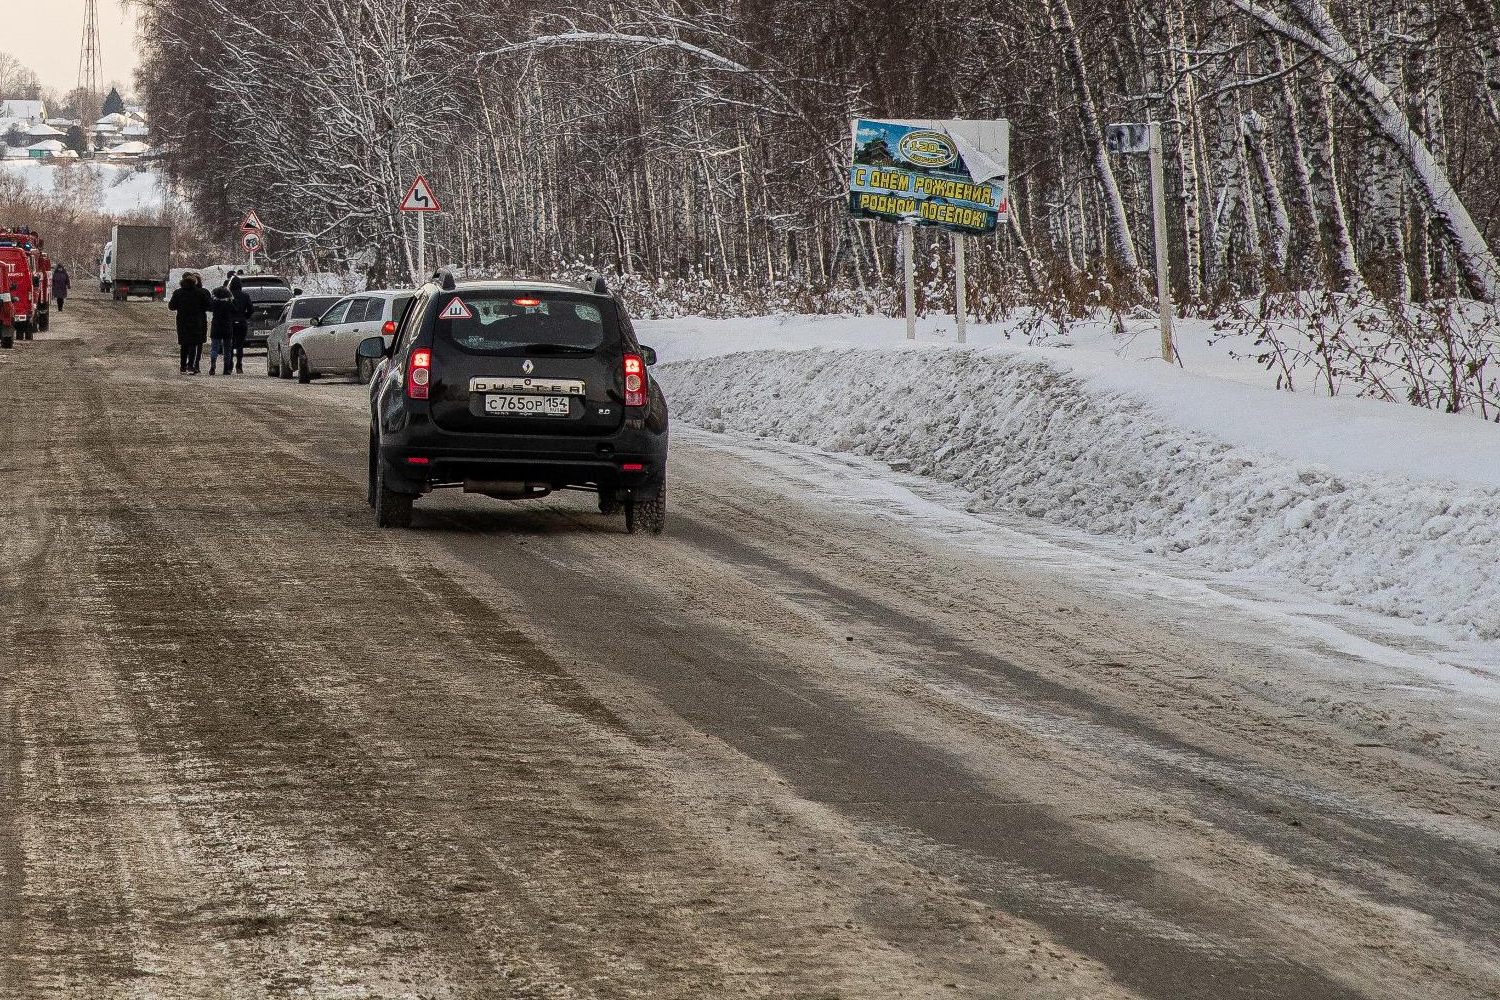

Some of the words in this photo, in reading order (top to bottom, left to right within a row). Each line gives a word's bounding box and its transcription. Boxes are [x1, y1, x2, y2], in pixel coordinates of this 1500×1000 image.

[856, 169, 866, 186] С
[870, 170, 909, 191] ДНЁМ
[914, 176, 995, 207] РОЖДЕНИЯ,
[860, 194, 915, 214] РОДНОЙ
[920, 202, 986, 228] ПОСЁЛОК!
[450, 307, 462, 316] Ш
[476, 383, 580, 393] DUSTER
[546, 397, 568, 408] 154
